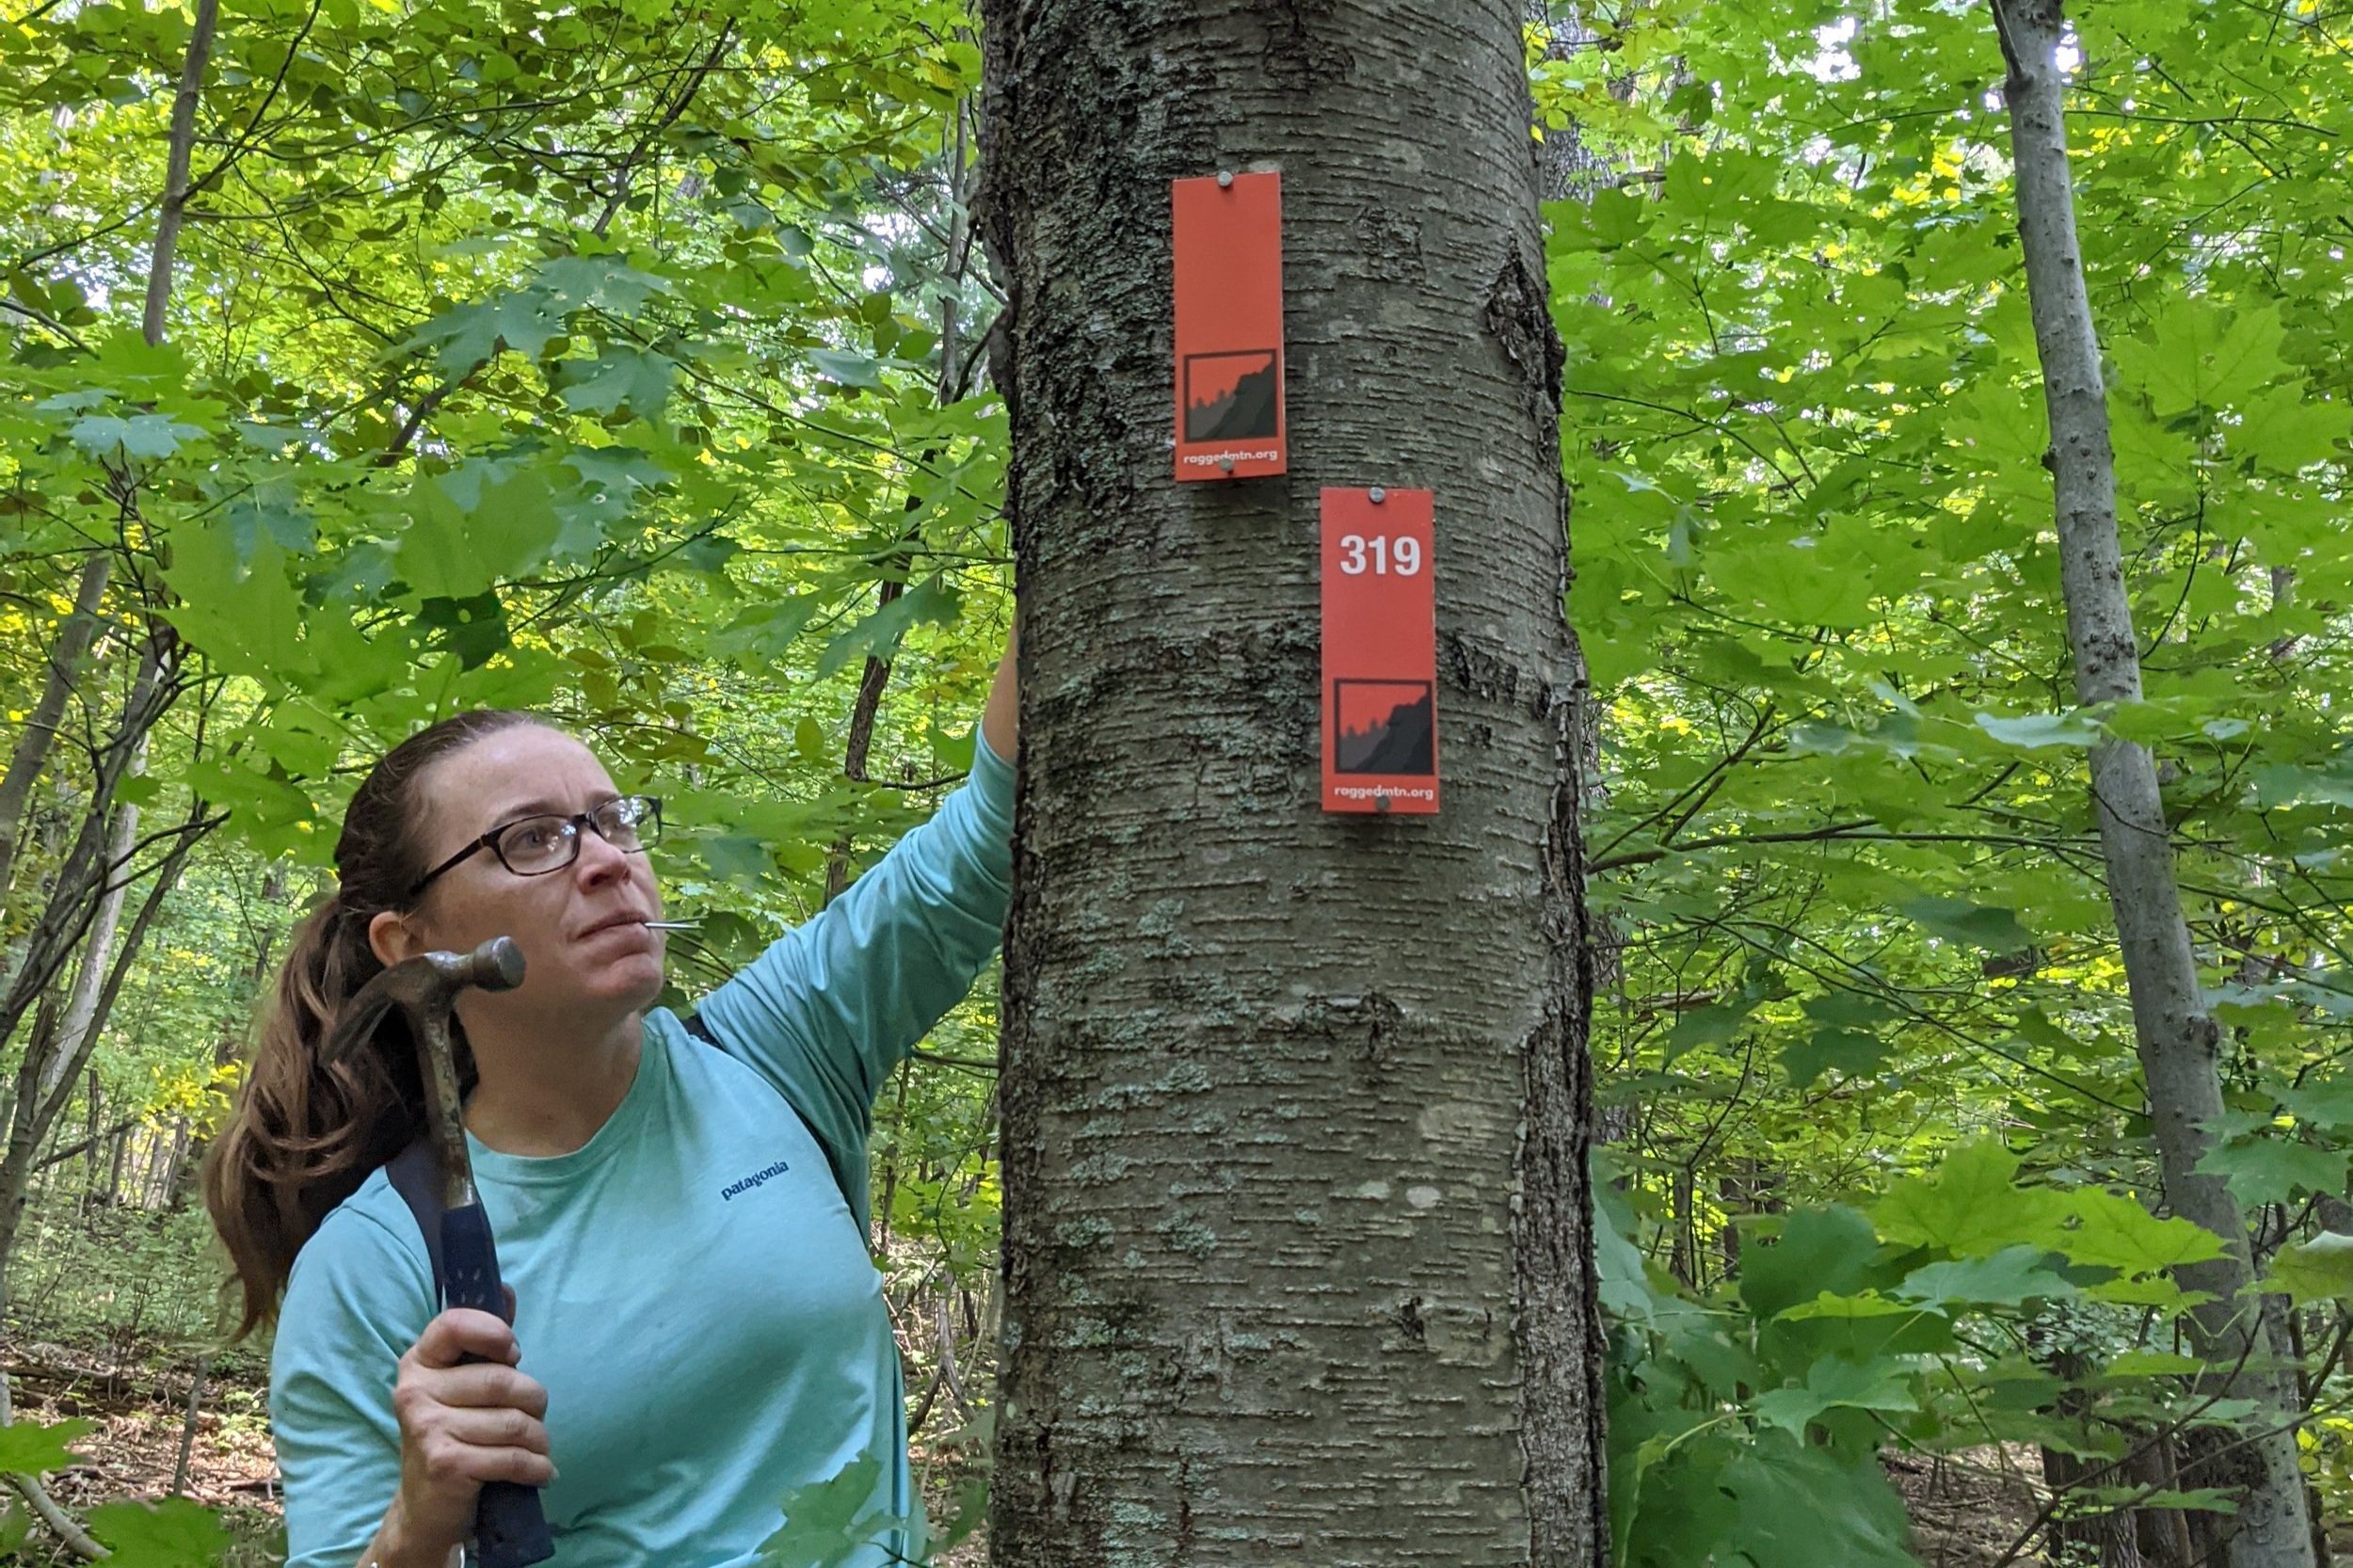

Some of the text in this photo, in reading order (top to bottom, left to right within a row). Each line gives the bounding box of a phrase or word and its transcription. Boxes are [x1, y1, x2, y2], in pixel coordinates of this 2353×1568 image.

[1340, 535, 1421, 576] 319
[1334, 784, 1433, 801] raggedmtn.org
[721, 1160, 790, 1202] patagonia
